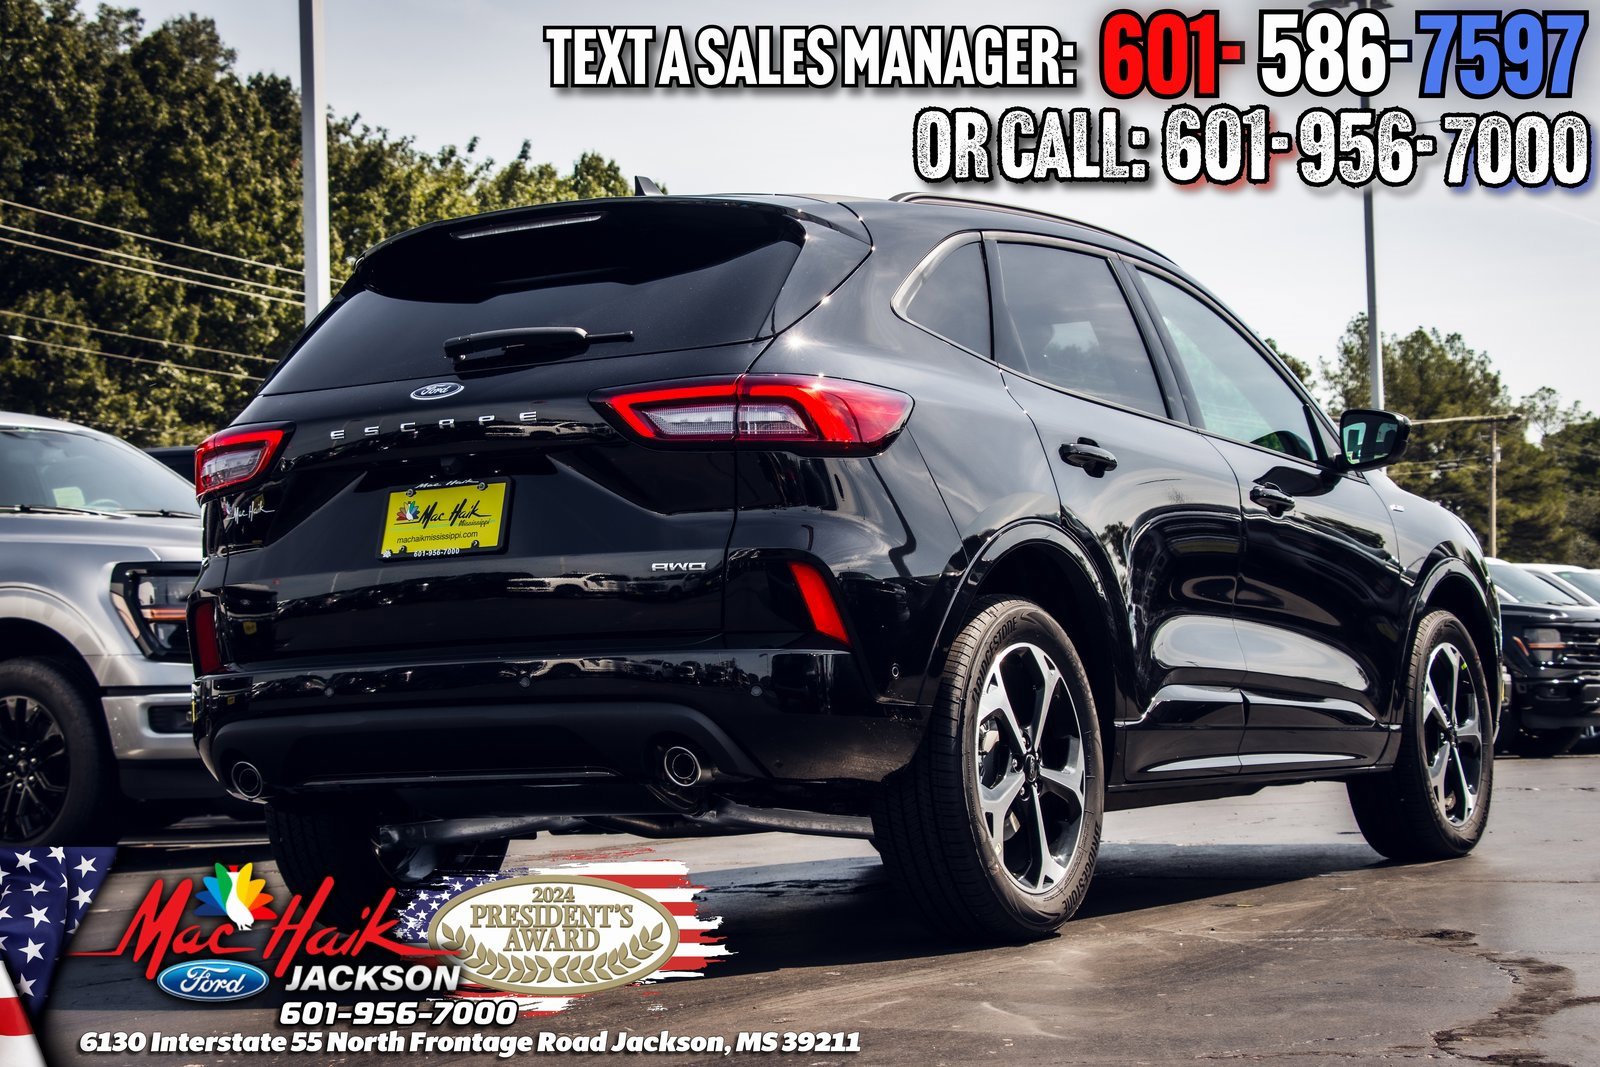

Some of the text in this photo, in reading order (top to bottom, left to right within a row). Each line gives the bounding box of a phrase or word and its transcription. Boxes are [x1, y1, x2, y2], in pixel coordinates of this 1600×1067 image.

[420, 383, 451, 396] Ford
[330, 411, 537, 440] ESCAPE
[406, 498, 491, 529] Mac Haik
[458, 519, 490, 528] Mississippi
[396, 530, 478, 544] machaikmississippi.com
[413, 547, 460, 557] 601-956-7000
[651, 562, 706, 572] AWD
